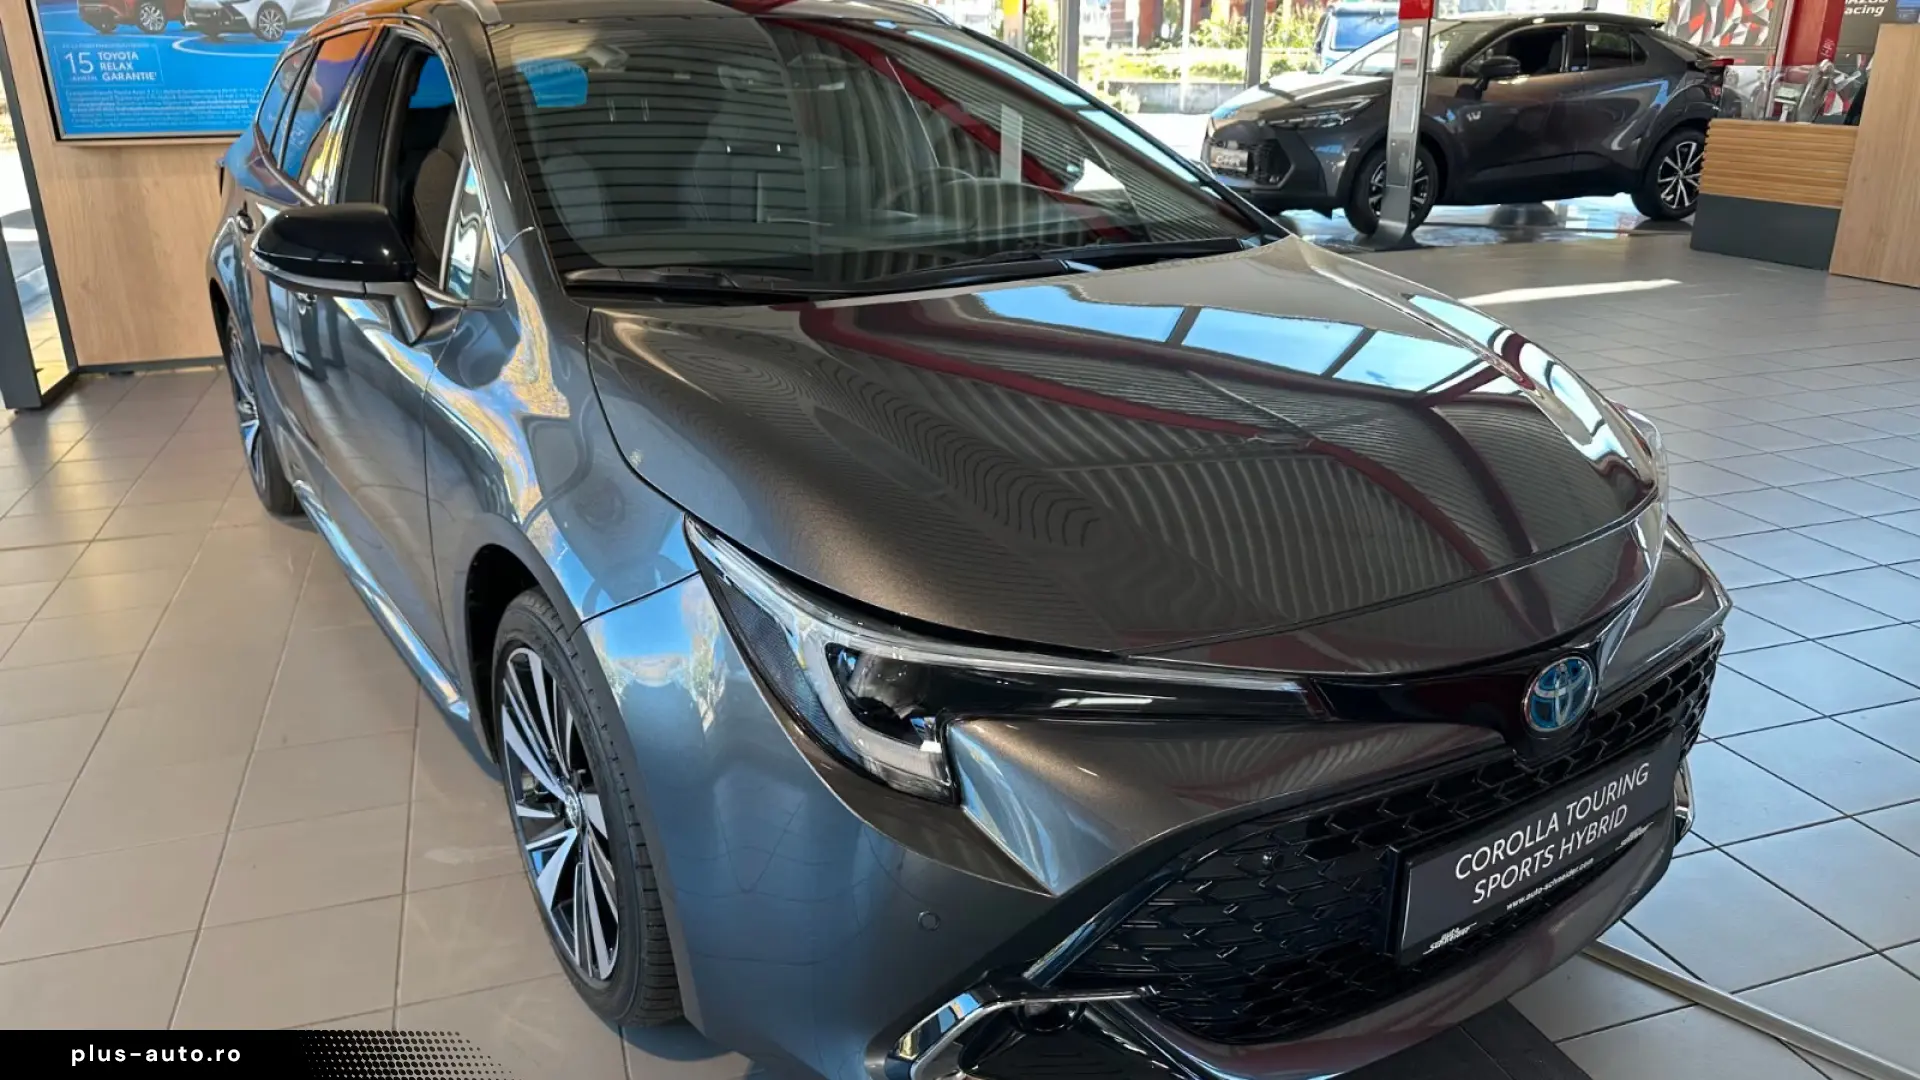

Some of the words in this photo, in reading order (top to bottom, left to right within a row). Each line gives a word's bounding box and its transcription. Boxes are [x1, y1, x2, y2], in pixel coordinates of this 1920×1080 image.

[1844, 5, 1885, 17] acing
[65, 52, 94, 74] 15
[97, 52, 139, 61] TOYOTA
[100, 62, 133, 71] RELAX
[1455, 813, 1559, 880] COROLLA
[1566, 762, 1650, 826] TOURING
[1472, 845, 1554, 904] SPORTS
[1559, 804, 1628, 860] HYBRID
[1506, 857, 1594, 911] www.auto-schneider.com
